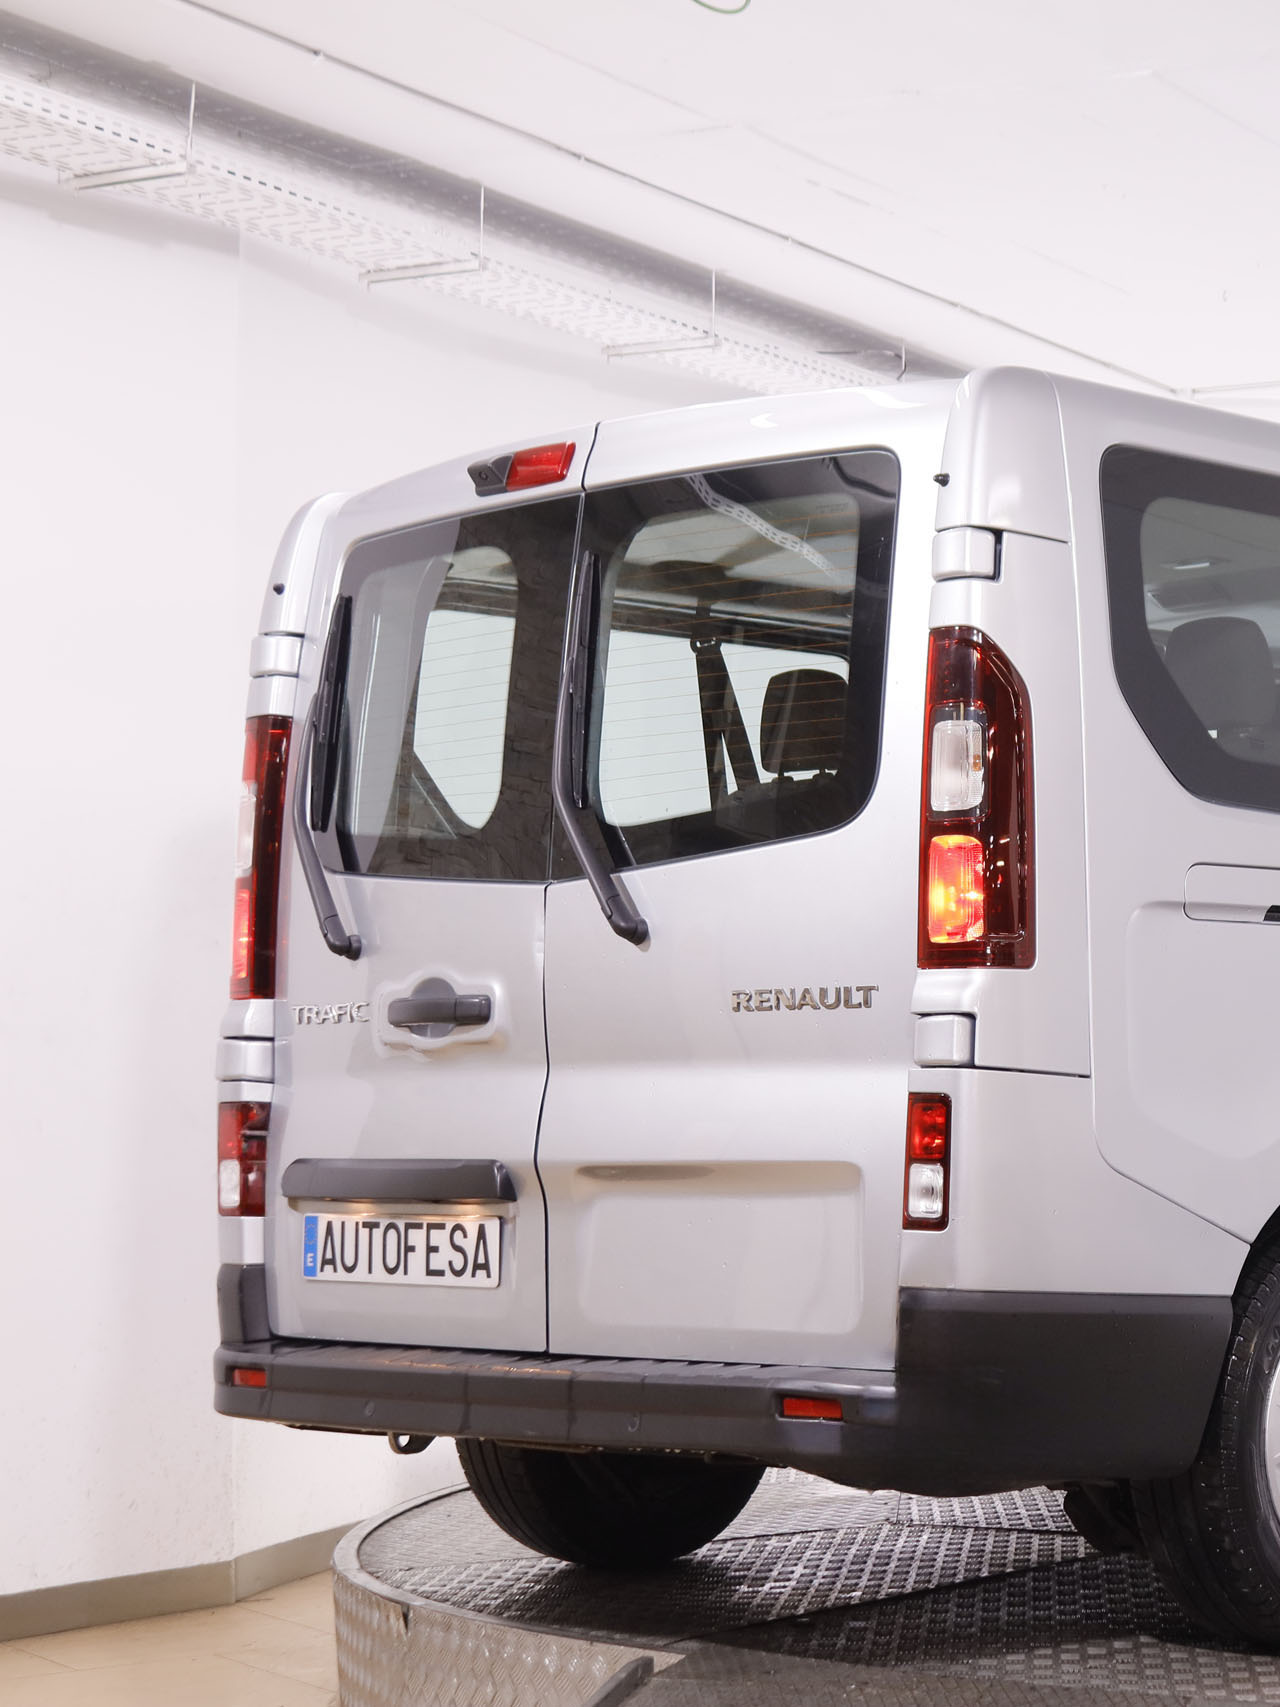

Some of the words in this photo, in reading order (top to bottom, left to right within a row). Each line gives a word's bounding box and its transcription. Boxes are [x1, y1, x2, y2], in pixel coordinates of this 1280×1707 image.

[731, 984, 879, 1013] RENAULT
[292, 1001, 370, 1025] TRAFIC
[306, 1252, 315, 1268] E
[320, 1220, 492, 1279] AUTOFESA
